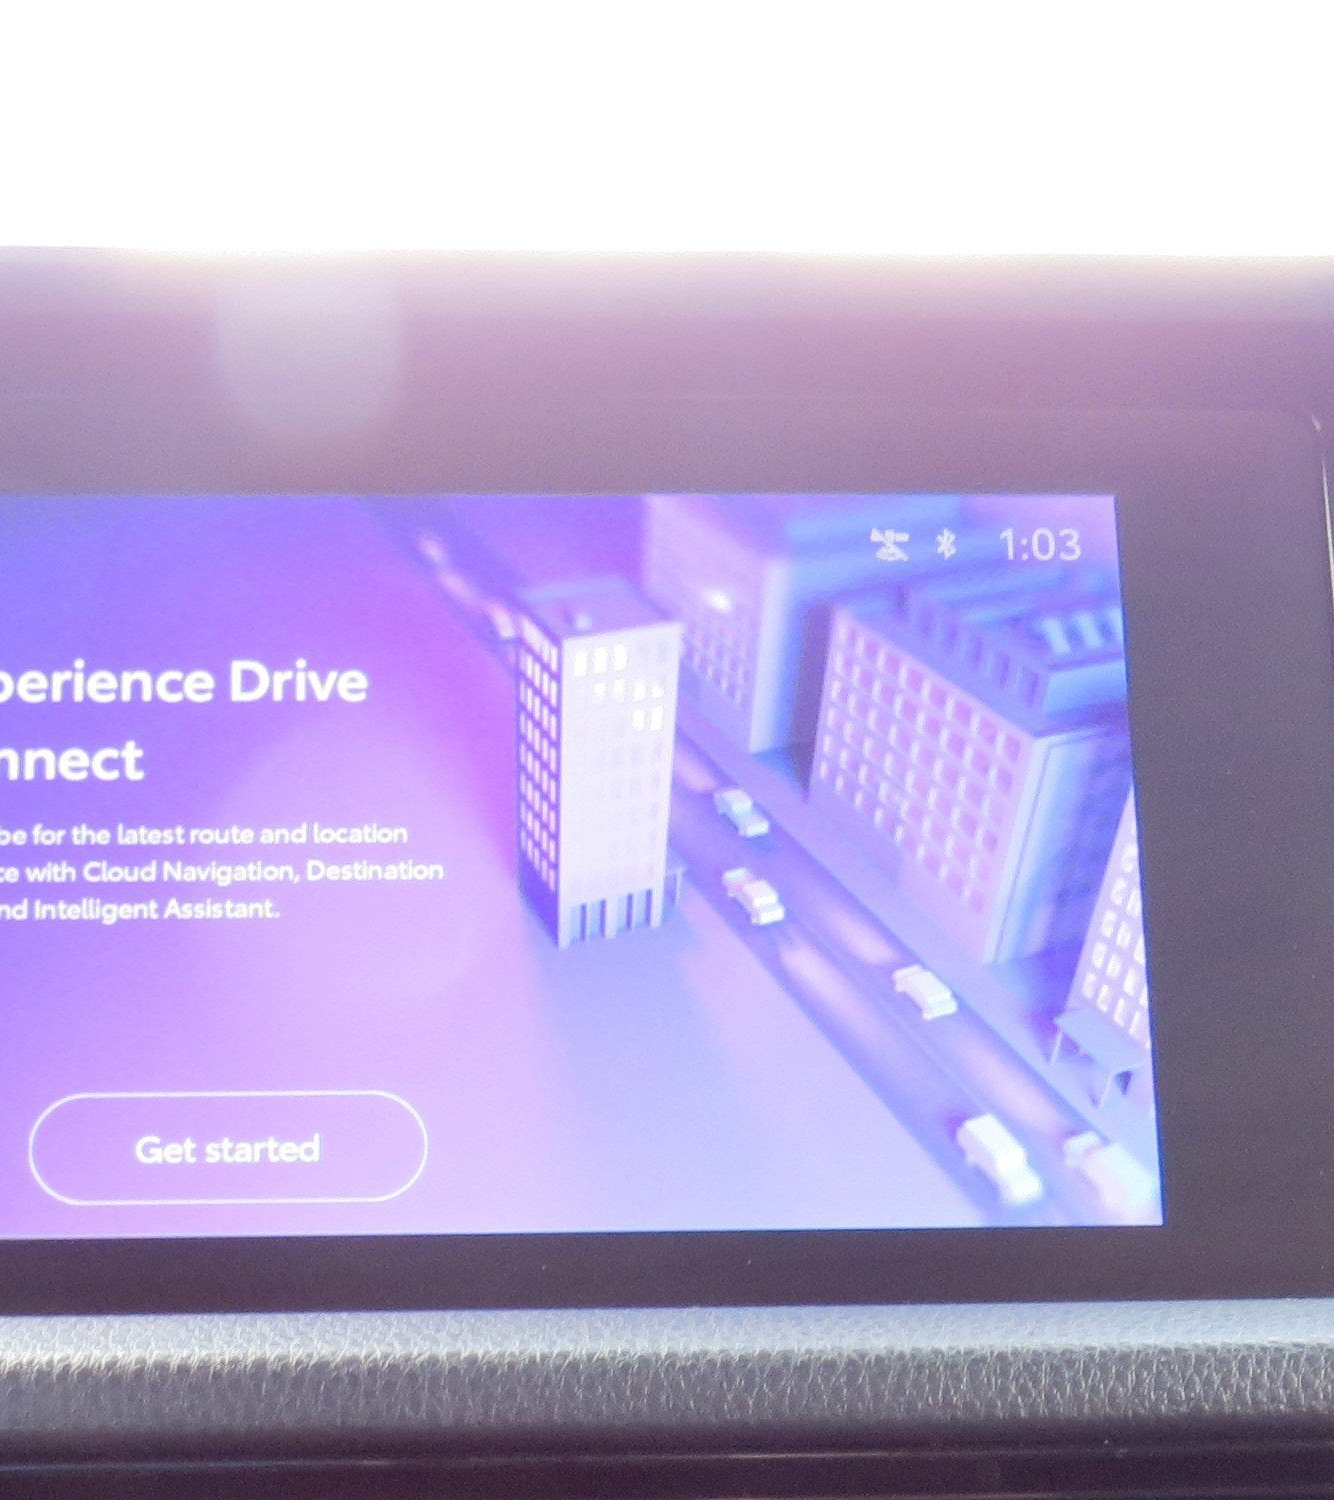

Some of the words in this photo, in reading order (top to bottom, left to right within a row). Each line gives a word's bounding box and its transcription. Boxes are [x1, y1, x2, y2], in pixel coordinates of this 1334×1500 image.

[998, 527, 1083, 562] 1:03
[229, 657, 369, 702] Drive
[32, 823, 66, 845] for
[71, 823, 111, 845] the
[117, 823, 185, 845] latest
[189, 823, 254, 845] route
[260, 822, 307, 844] and
[312, 822, 409, 844] location
[25, 862, 76, 884] with
[82, 860, 157, 883] Cloud
[162, 860, 300, 888] Navigation,
[306, 859, 445, 882] Destination
[33, 898, 159, 925] Intelligent
[163, 898, 280, 920] Assistant.
[134, 1134, 196, 1165] Get
[203, 1132, 321, 1164] started
